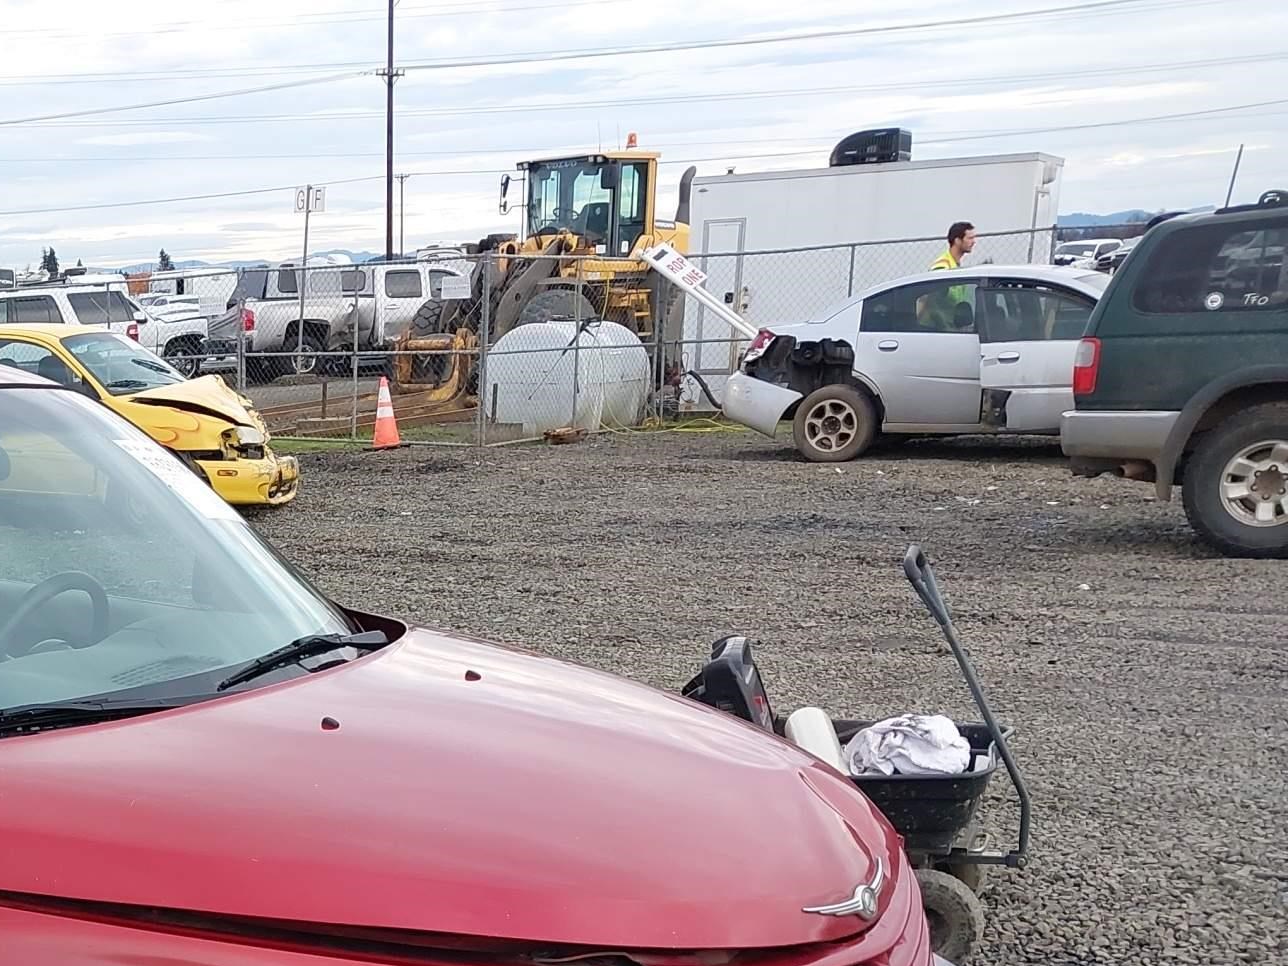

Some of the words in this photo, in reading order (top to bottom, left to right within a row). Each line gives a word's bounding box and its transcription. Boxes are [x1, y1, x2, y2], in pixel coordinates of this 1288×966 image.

[296, 189, 305, 210] G
[314, 189, 322, 209] F
[666, 257, 687, 274] ROP
[682, 269, 703, 286] ONE
